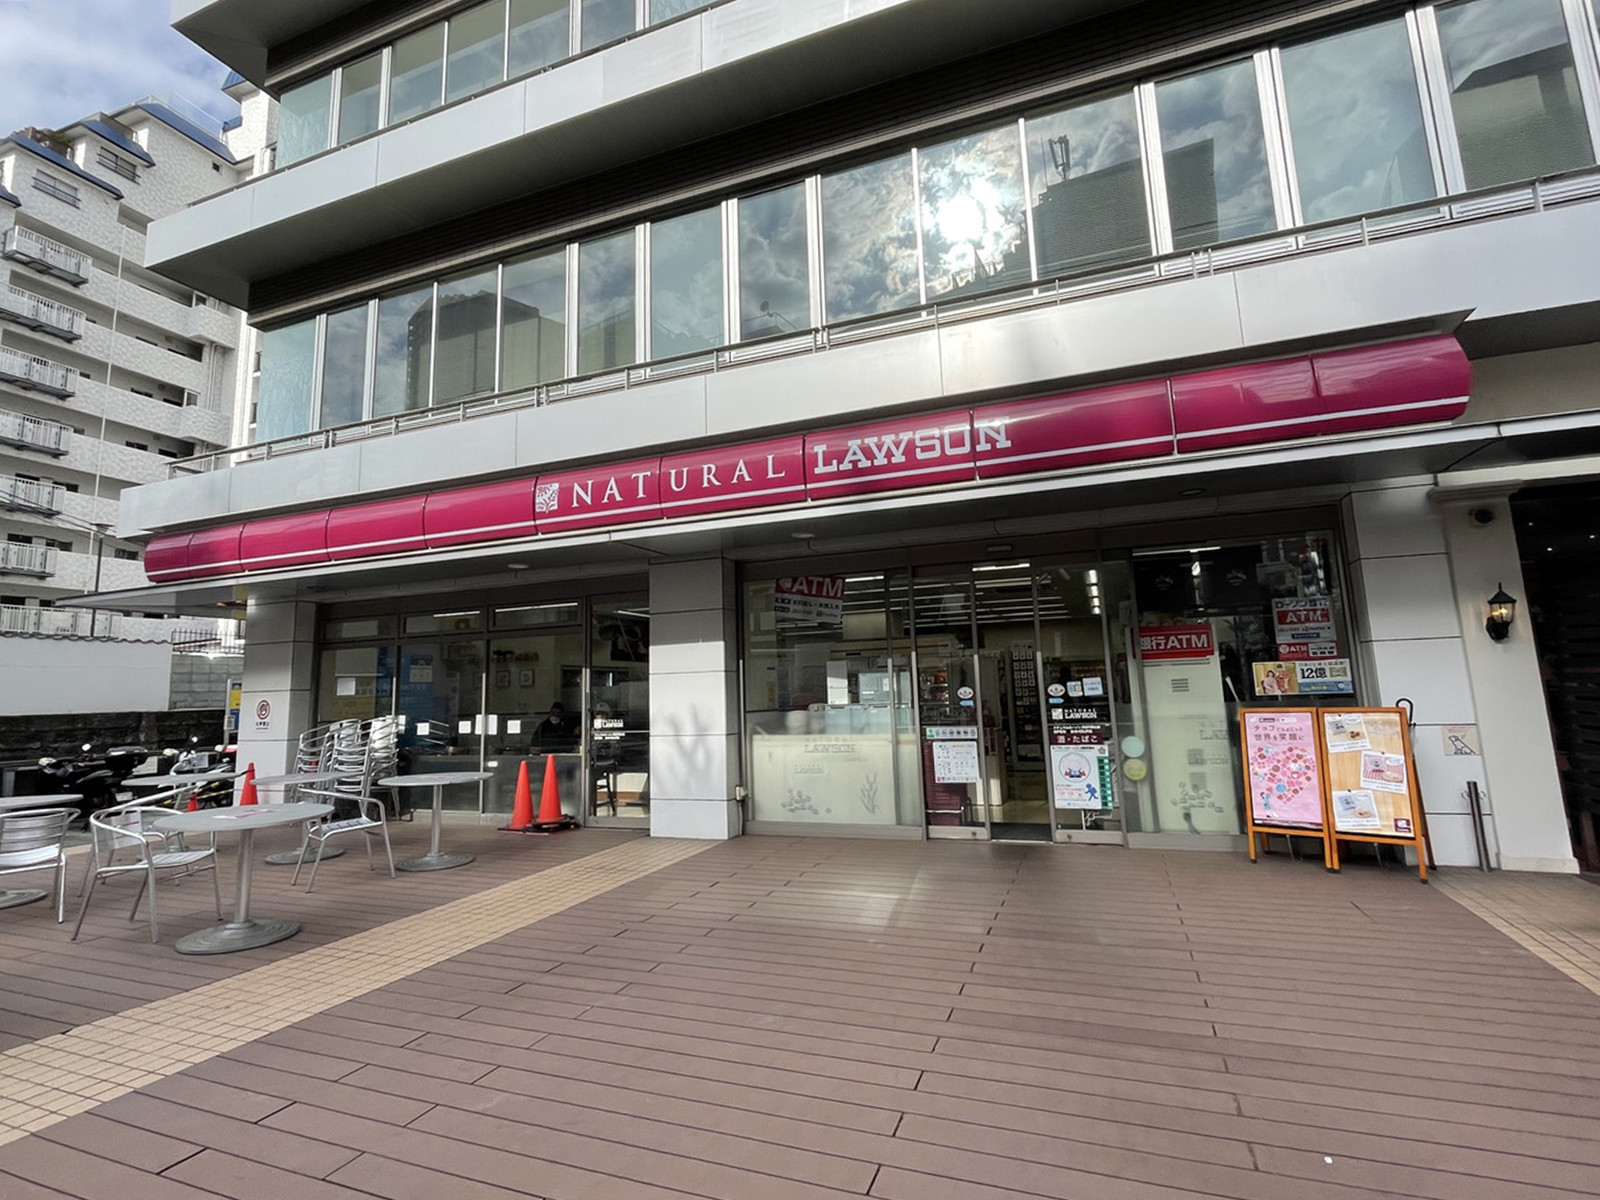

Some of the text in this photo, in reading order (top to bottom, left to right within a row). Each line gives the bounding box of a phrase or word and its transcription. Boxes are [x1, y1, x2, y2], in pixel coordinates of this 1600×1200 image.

[571, 416, 1012, 509] NATURAL LAWSON
[791, 576, 843, 598] ATM
[1286, 610, 1323, 623] ATM
[1300, 667, 1327, 679] 12億
[1057, 735, 1098, 743] 酒・たばこ
